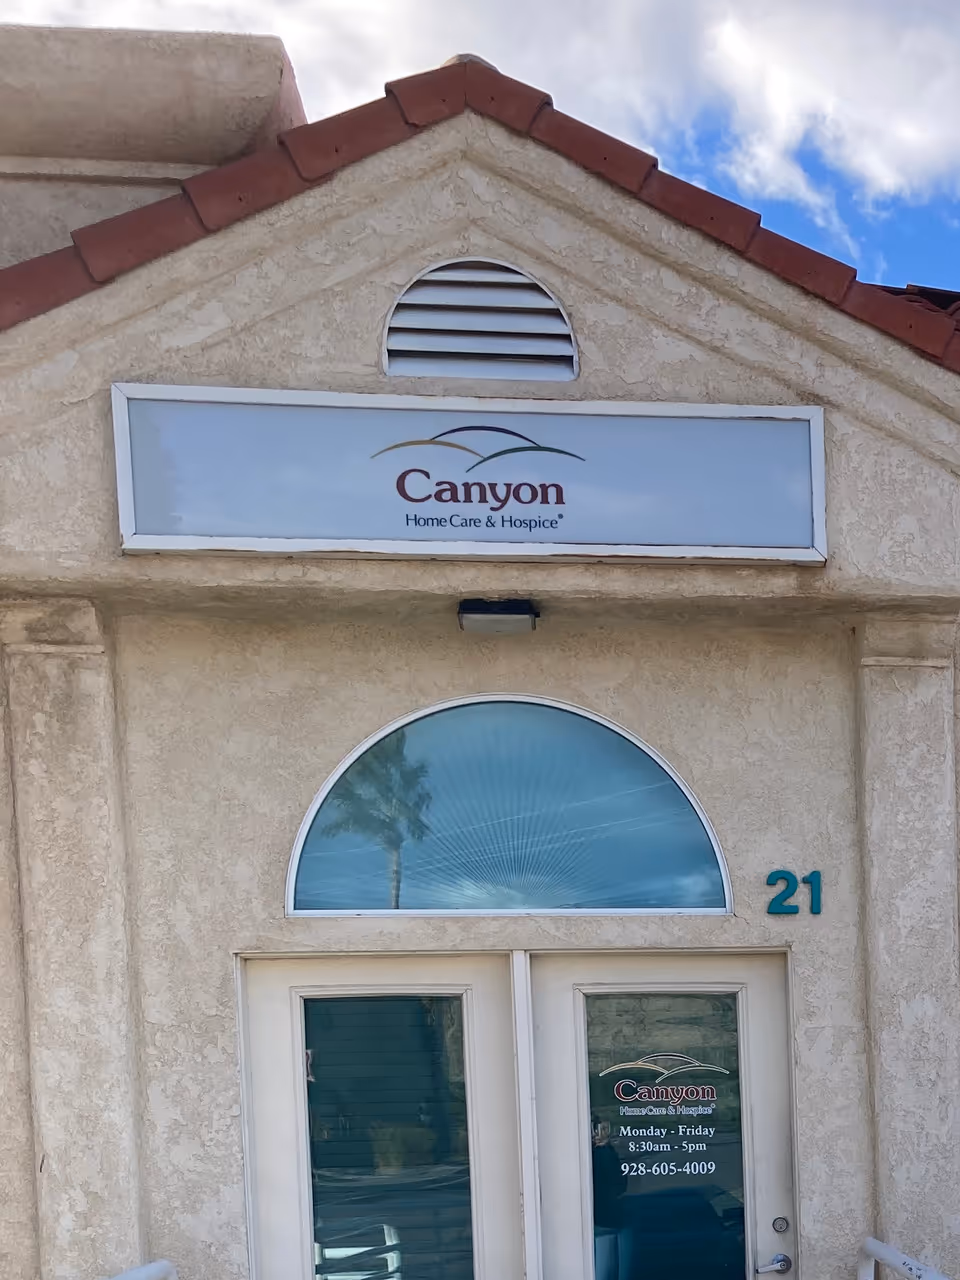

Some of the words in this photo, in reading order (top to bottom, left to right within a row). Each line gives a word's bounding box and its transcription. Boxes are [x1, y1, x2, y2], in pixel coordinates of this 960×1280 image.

[396, 468, 566, 512] Canyon
[485, 515, 496, 528] &
[766, 869, 822, 915] 21
[614, 1079, 717, 1105] Canyon
[667, 1105, 675, 1115] &
[619, 1125, 667, 1138] Monday
[678, 1124, 716, 1137] Friday
[628, 1141, 671, 1152] 8:30am
[681, 1140, 707, 1153] 5pm
[620, 1161, 716, 1176] 928-605-4009
